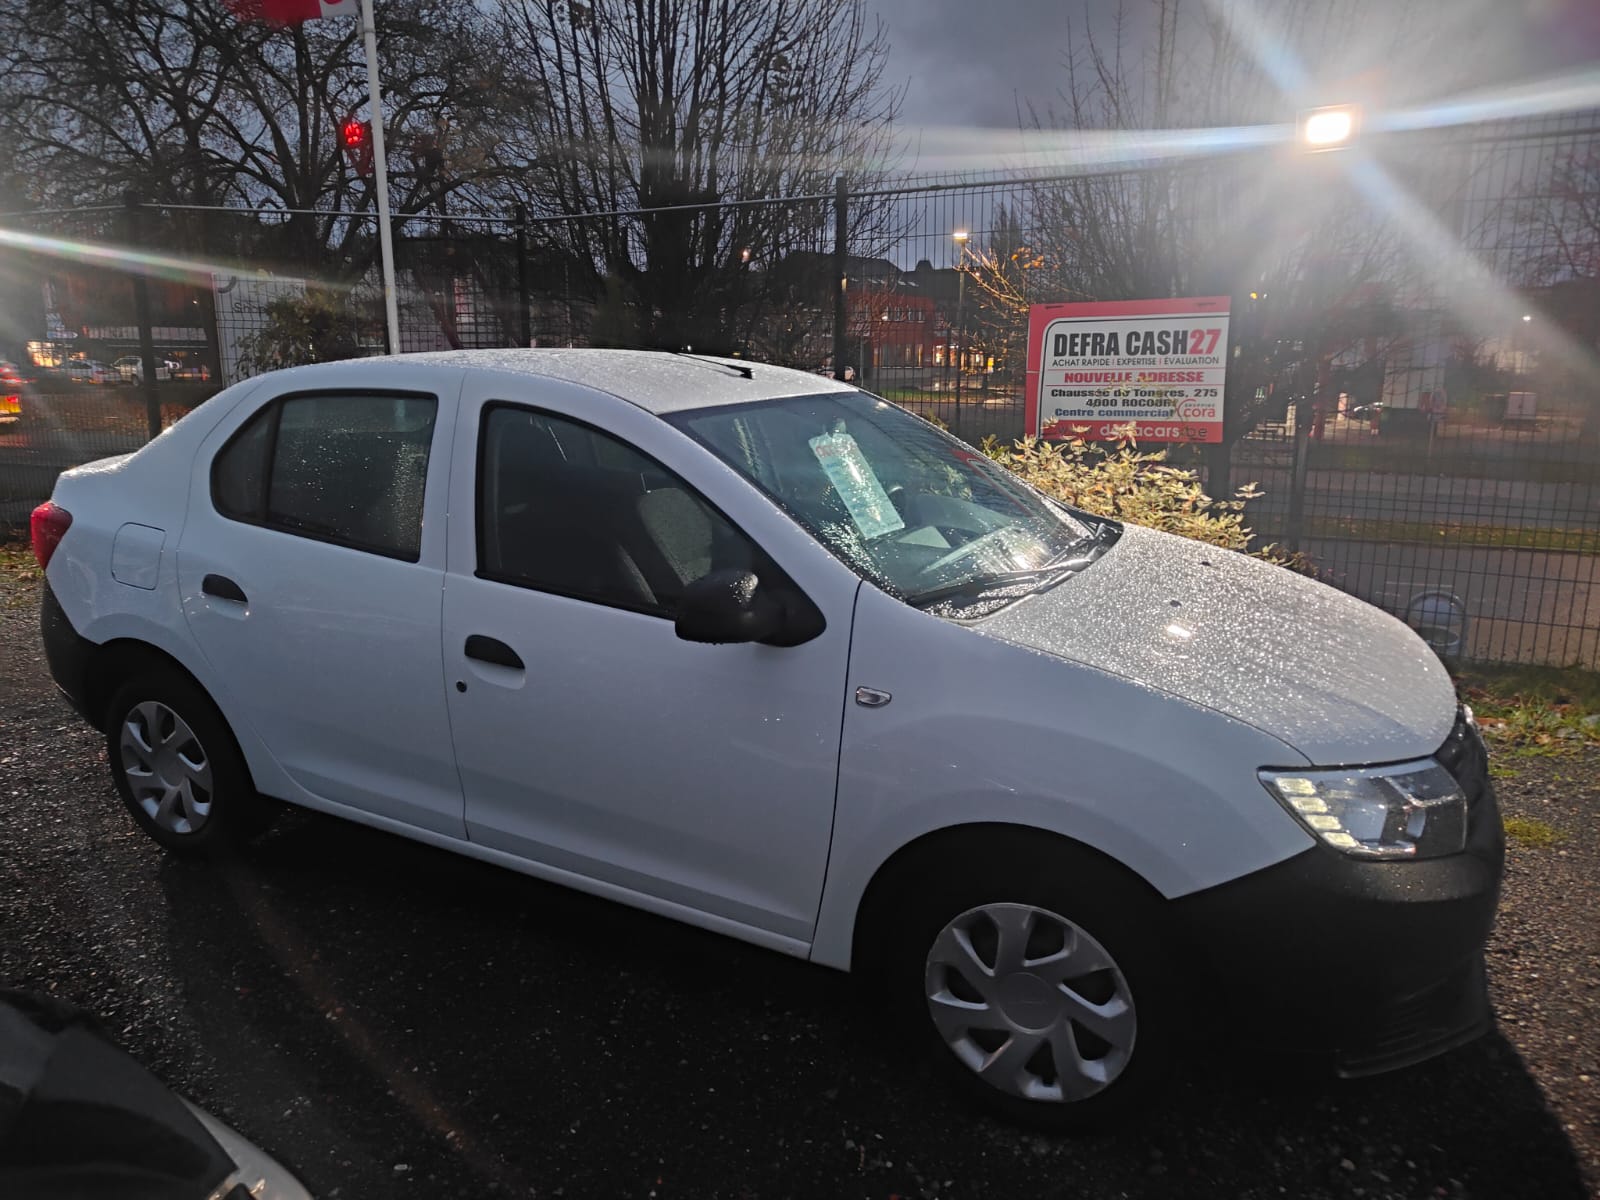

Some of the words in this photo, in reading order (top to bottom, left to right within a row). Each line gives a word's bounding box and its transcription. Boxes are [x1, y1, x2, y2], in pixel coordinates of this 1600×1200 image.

[1054, 332, 1120, 357] DEFRA
[1125, 328, 1222, 356] CASH27
[1052, 358, 1080, 367] ACHAT
[1081, 358, 1112, 366] RAPIDE
[1117, 357, 1156, 366] EXPERTISE
[1064, 372, 1133, 383] NOUVELLE
[1136, 371, 1205, 383] ADRESSE
[1193, 388, 1218, 397] 275
[1085, 398, 1118, 407] 4000
[1054, 407, 1094, 417] Centre
[1097, 407, 1173, 417] commercial
[1183, 408, 1215, 418] cora
